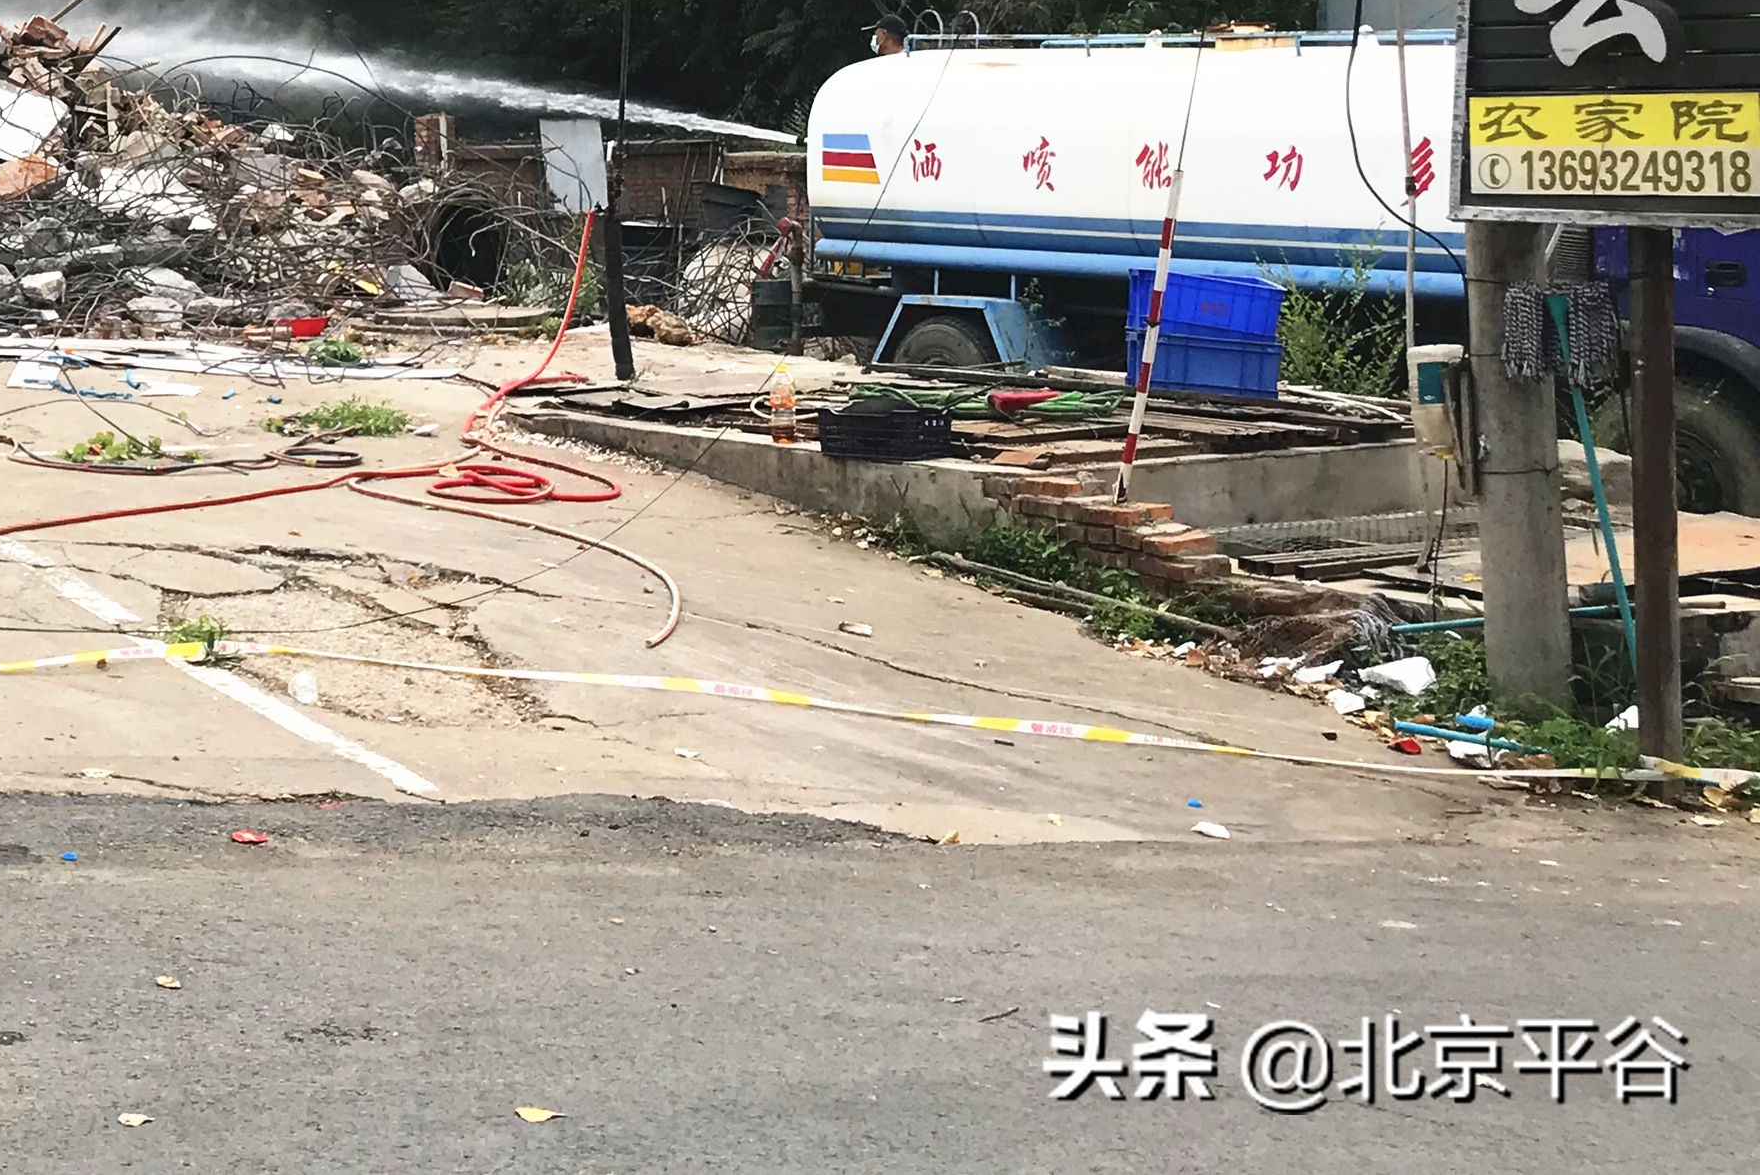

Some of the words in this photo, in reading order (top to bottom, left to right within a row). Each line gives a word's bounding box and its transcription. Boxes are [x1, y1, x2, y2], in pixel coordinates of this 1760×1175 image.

[1478, 98, 1749, 143] 农家院
[1520, 149, 1752, 193] 13693249318
